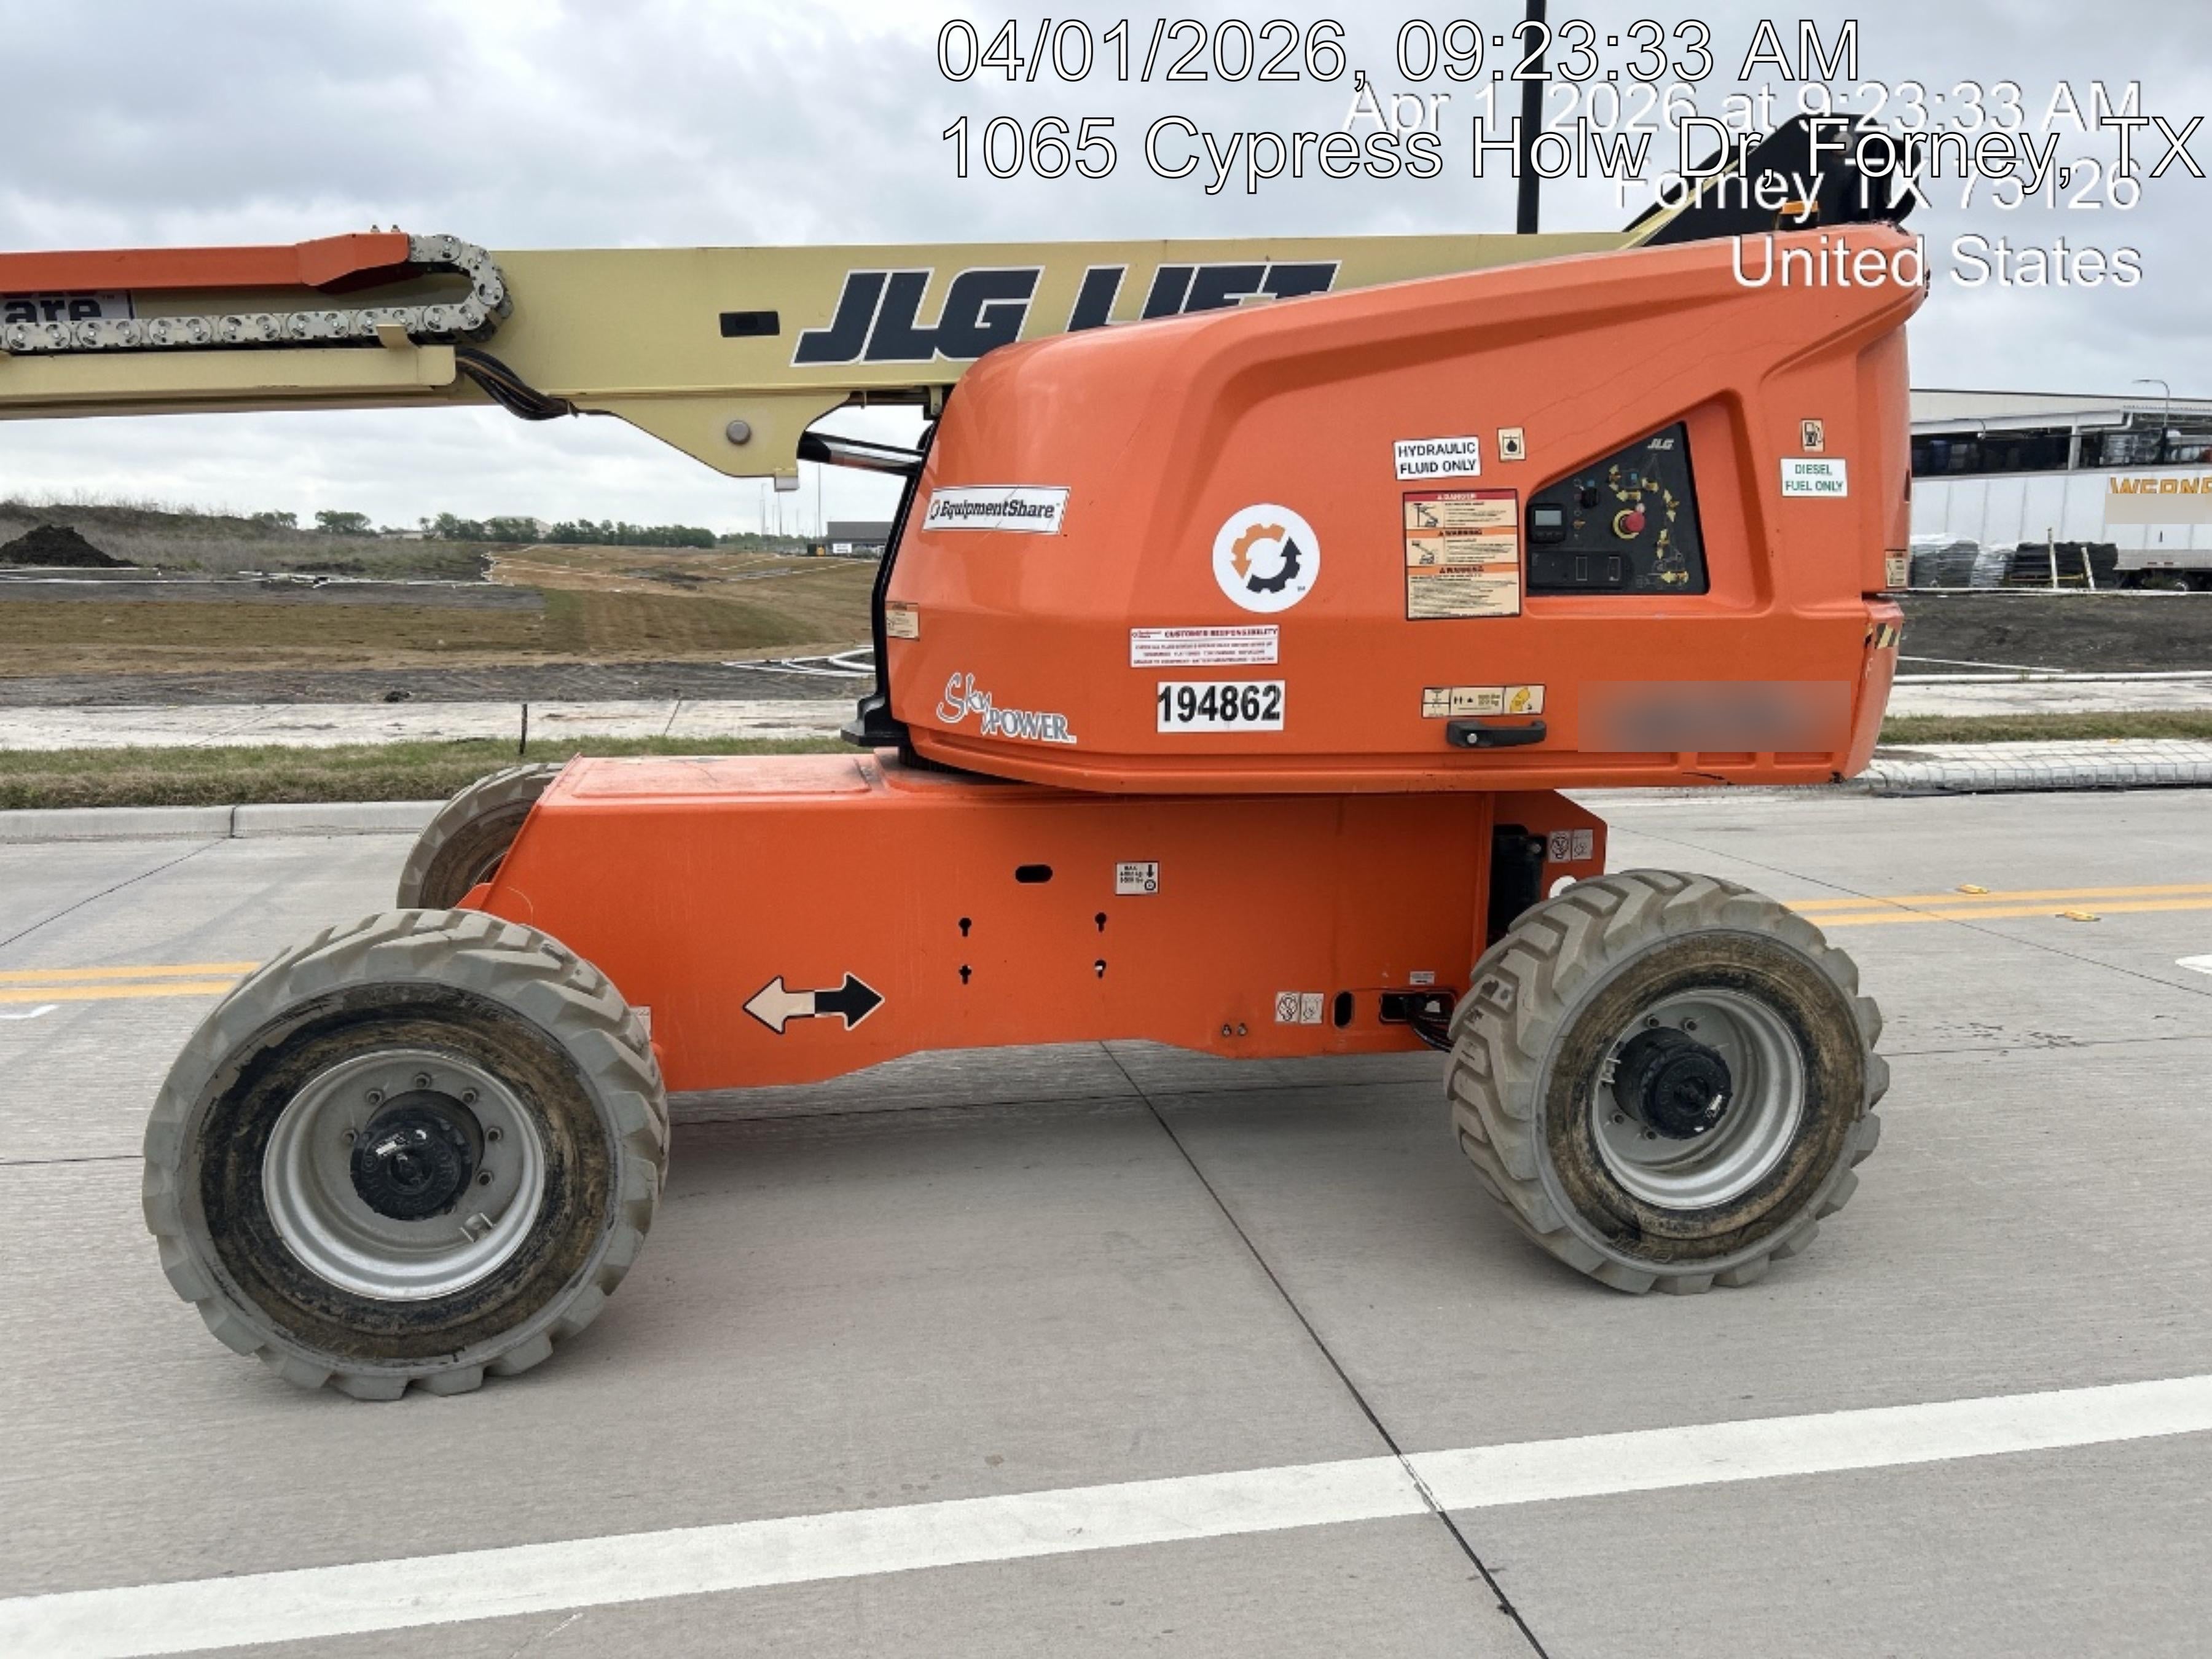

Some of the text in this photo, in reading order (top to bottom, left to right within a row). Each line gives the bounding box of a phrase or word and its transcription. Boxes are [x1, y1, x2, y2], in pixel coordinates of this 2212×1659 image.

[790, 265, 1045, 364] JLG
[1398, 442, 1475, 457] HYDRAULIC
[1647, 438, 1674, 450] JLG
[1400, 458, 1477, 475] FLUID ONLY
[1795, 464, 1832, 476] DIESEL
[1786, 480, 1843, 492] FUEL ONLY
[939, 499, 1055, 520] EquipmentShare
[936, 673, 992, 735] Sky
[1158, 684, 1282, 723] 194862
[989, 708, 1069, 741] POWER
